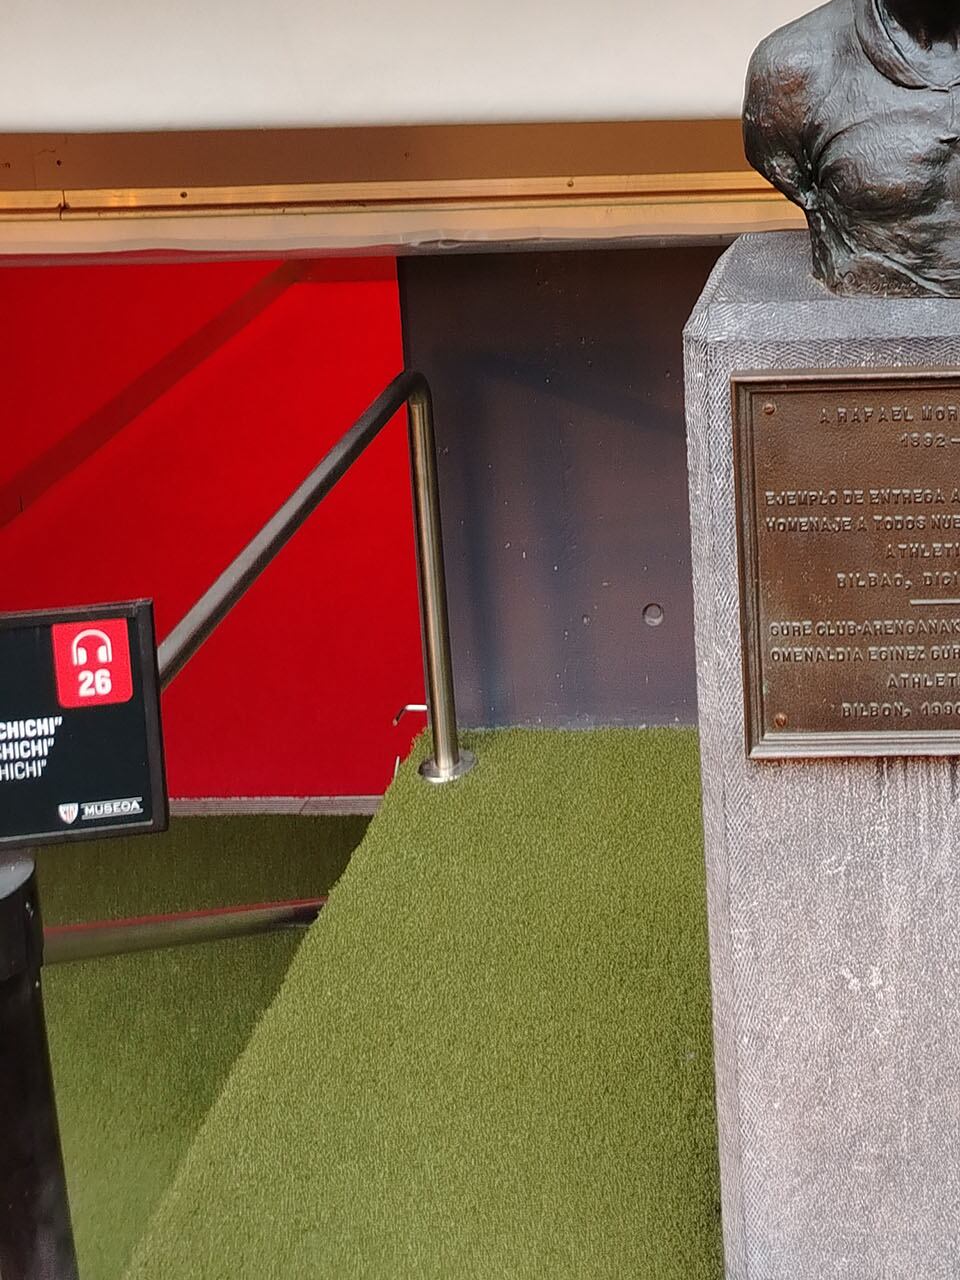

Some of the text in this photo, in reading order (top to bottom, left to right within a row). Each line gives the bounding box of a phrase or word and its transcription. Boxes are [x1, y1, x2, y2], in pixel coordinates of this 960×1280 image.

[819, 407, 830, 424] A
[836, 405, 914, 423] RAFAEL
[765, 490, 838, 506] EJEMPLO
[843, 489, 864, 505] DE
[869, 488, 945, 505] ENTREGA
[951, 487, 960, 504] A
[765, 516, 851, 533] HOMENAJE
[857, 516, 867, 532] A
[873, 514, 926, 531] TODOS
[836, 572, 913, 590] BILBAO,
[769, 620, 812, 637] GURE
[771, 646, 864, 663] OMENALDIA
[868, 645, 926, 662] EGINEZ
[78, 669, 113, 697] 26
[841, 701, 911, 719] BILBON,
[84, 800, 140, 817] MUSEOA
